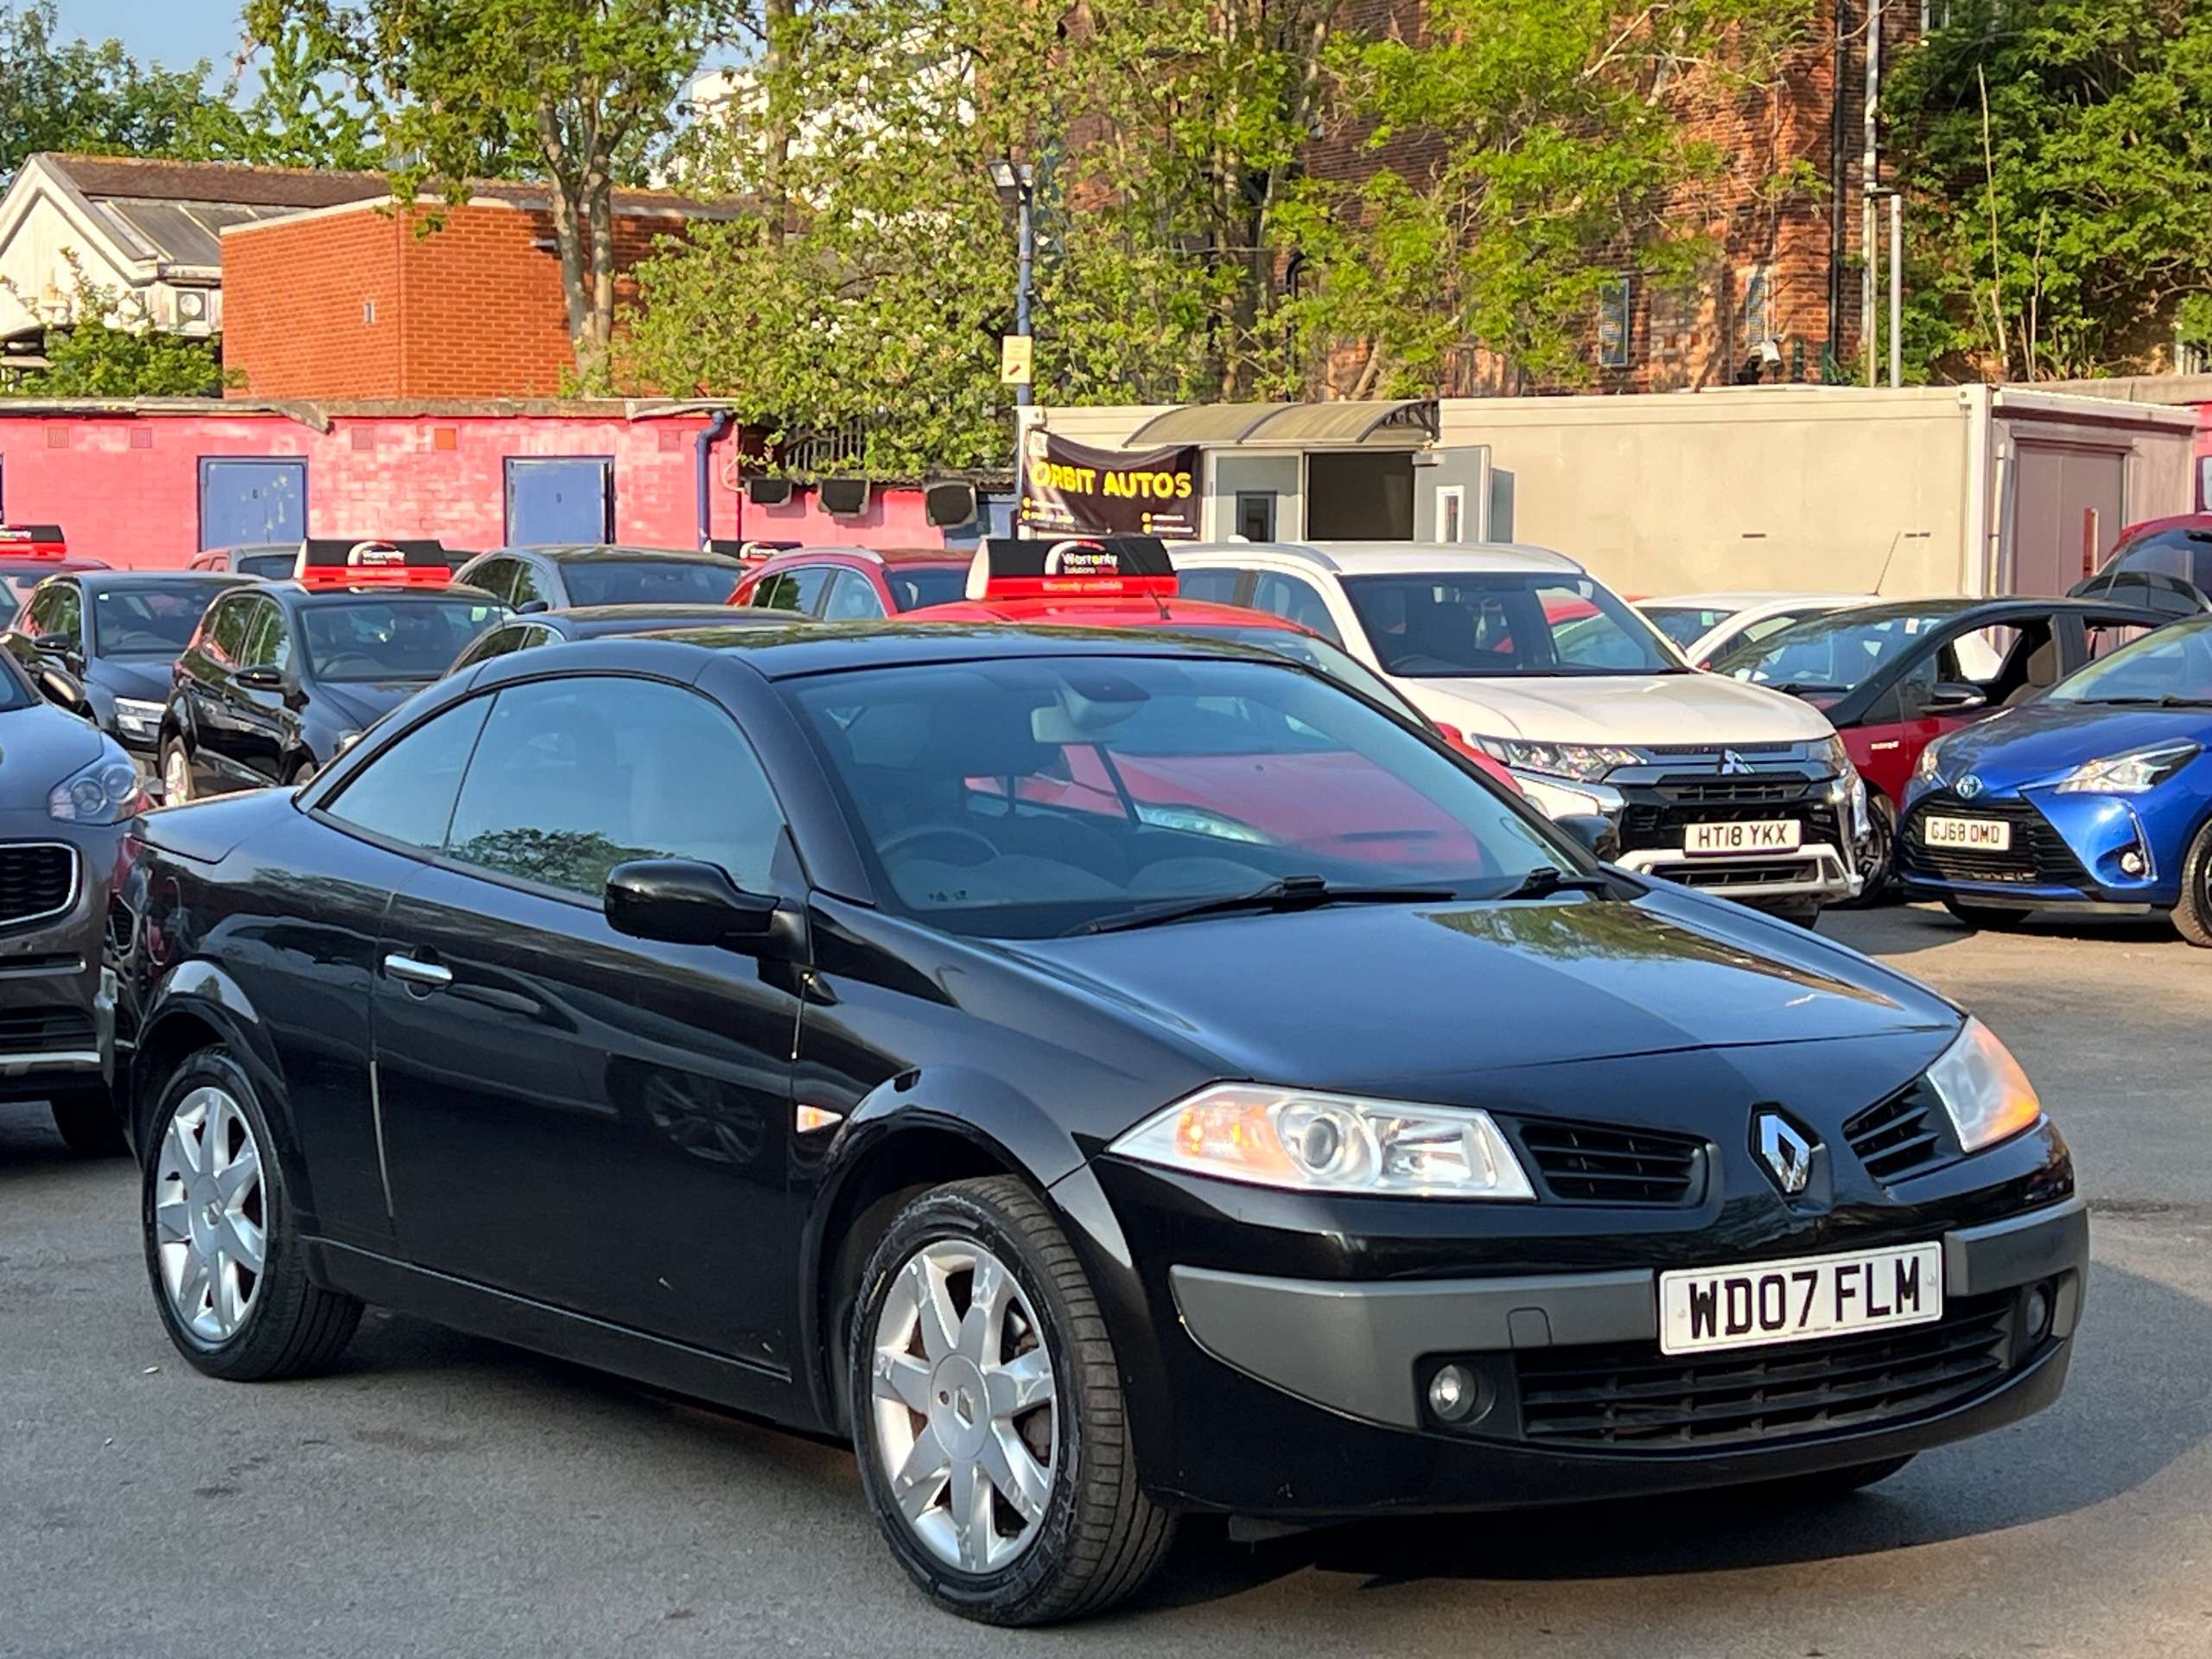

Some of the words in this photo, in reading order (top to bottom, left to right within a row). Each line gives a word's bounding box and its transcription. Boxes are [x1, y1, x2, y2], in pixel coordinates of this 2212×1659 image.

[1030, 461, 1096, 495] ORBIT
[1103, 471, 1192, 499] AUTOS
[1061, 552, 1118, 567] Warranty
[1698, 825, 1743, 848] HT18
[1749, 823, 1787, 846] YKX
[1930, 821, 1966, 842] GJ68
[1688, 1269, 1818, 1339] WD07
[1834, 1255, 1920, 1322] FLM
